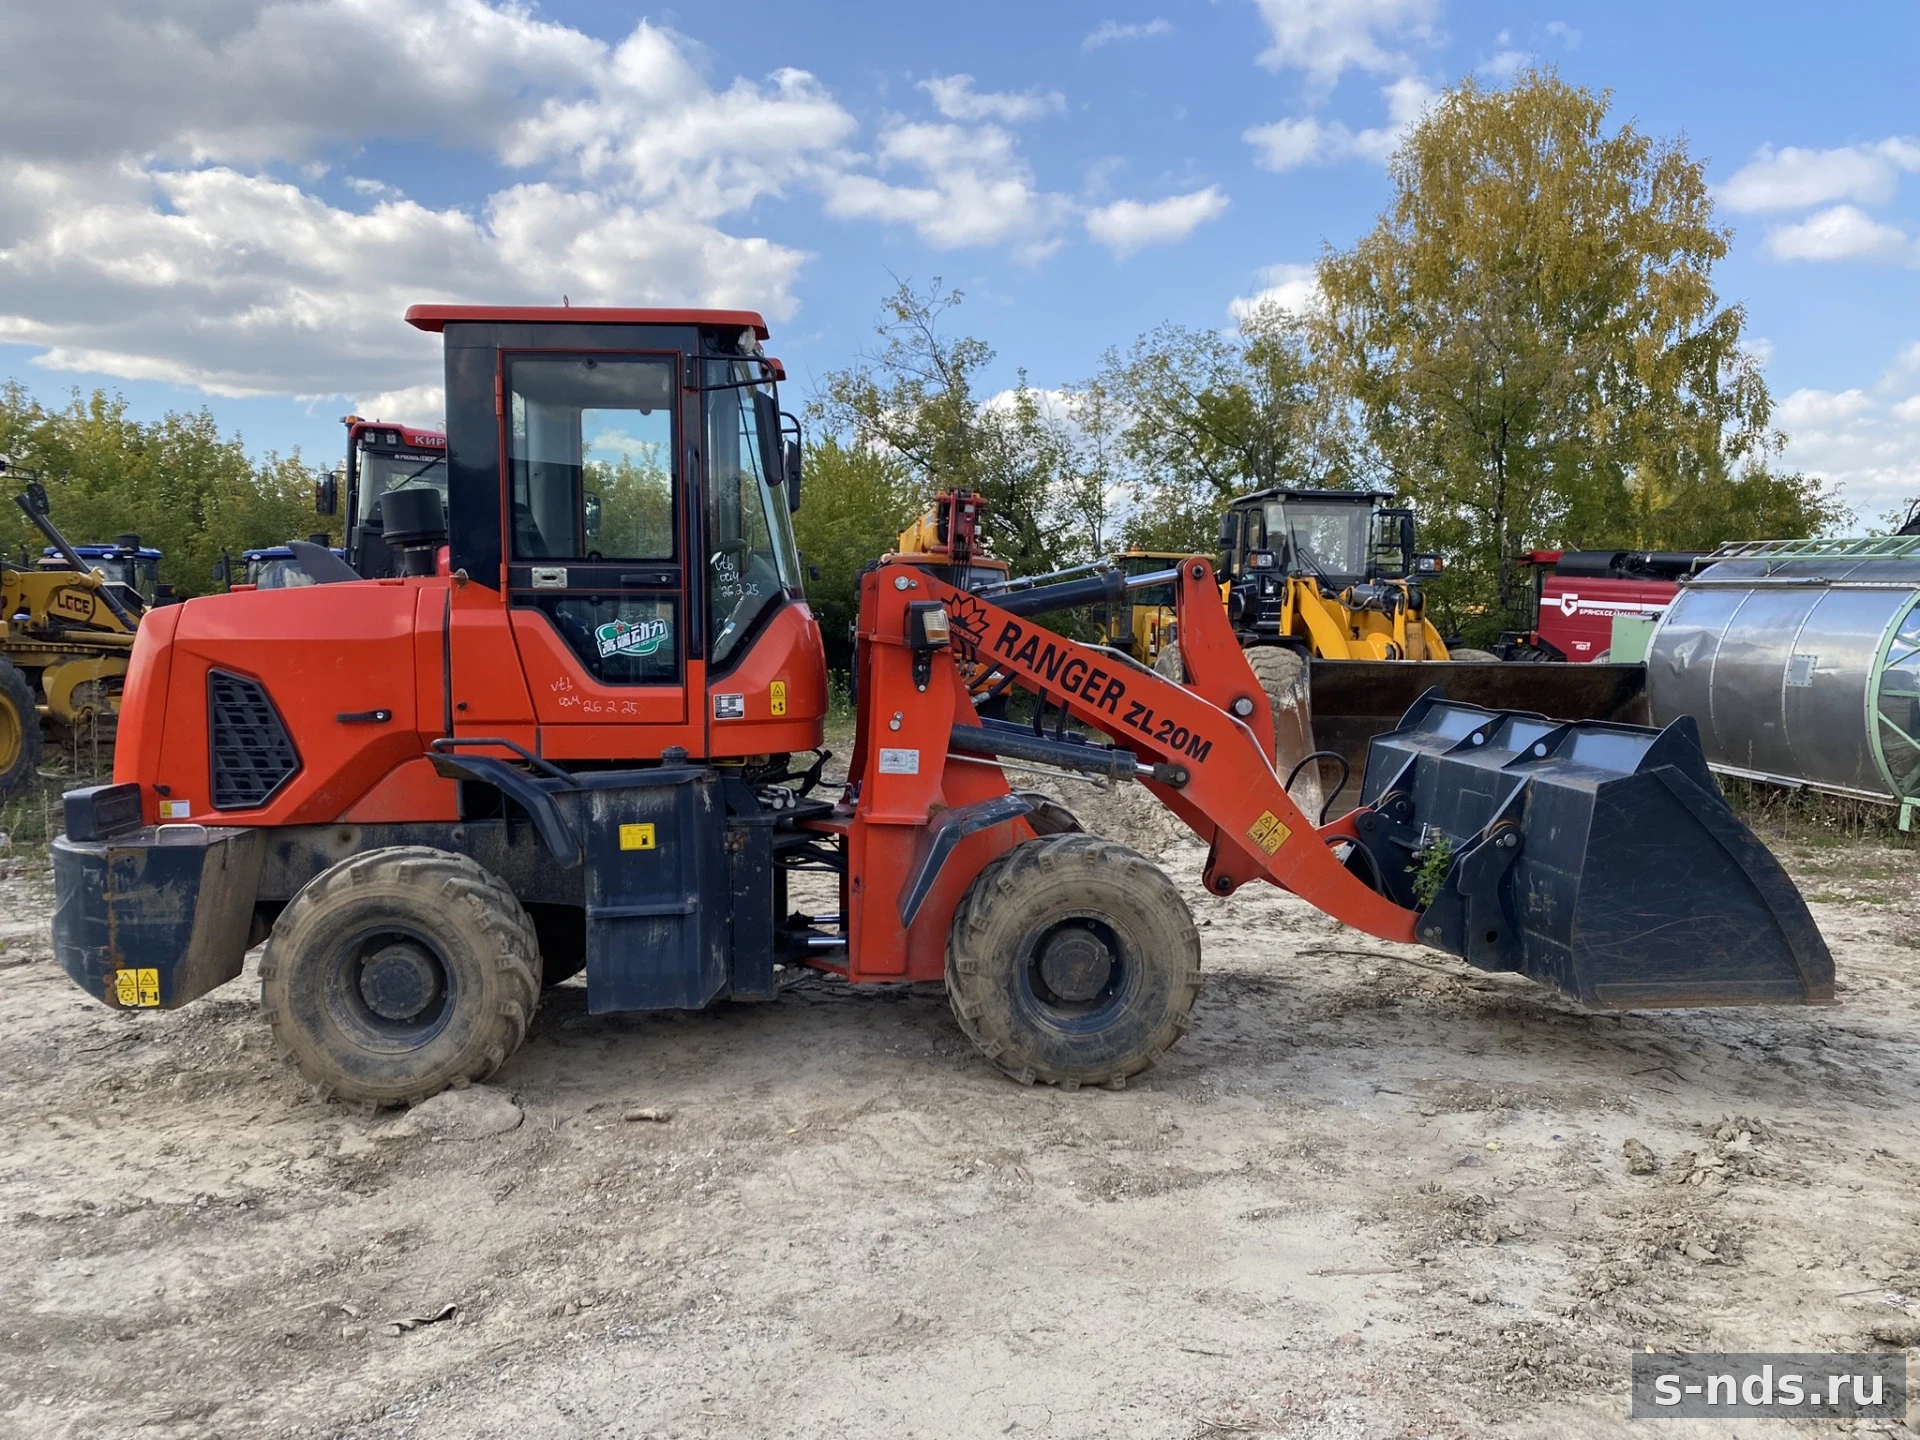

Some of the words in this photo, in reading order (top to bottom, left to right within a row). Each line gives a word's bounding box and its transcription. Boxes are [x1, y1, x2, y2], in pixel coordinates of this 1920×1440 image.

[415, 435, 446, 446] КИР
[993, 620, 1126, 715] RANGER
[1122, 700, 1213, 763] ZL20M
[583, 700, 602, 713] 26
[605, 700, 618, 713] 2
